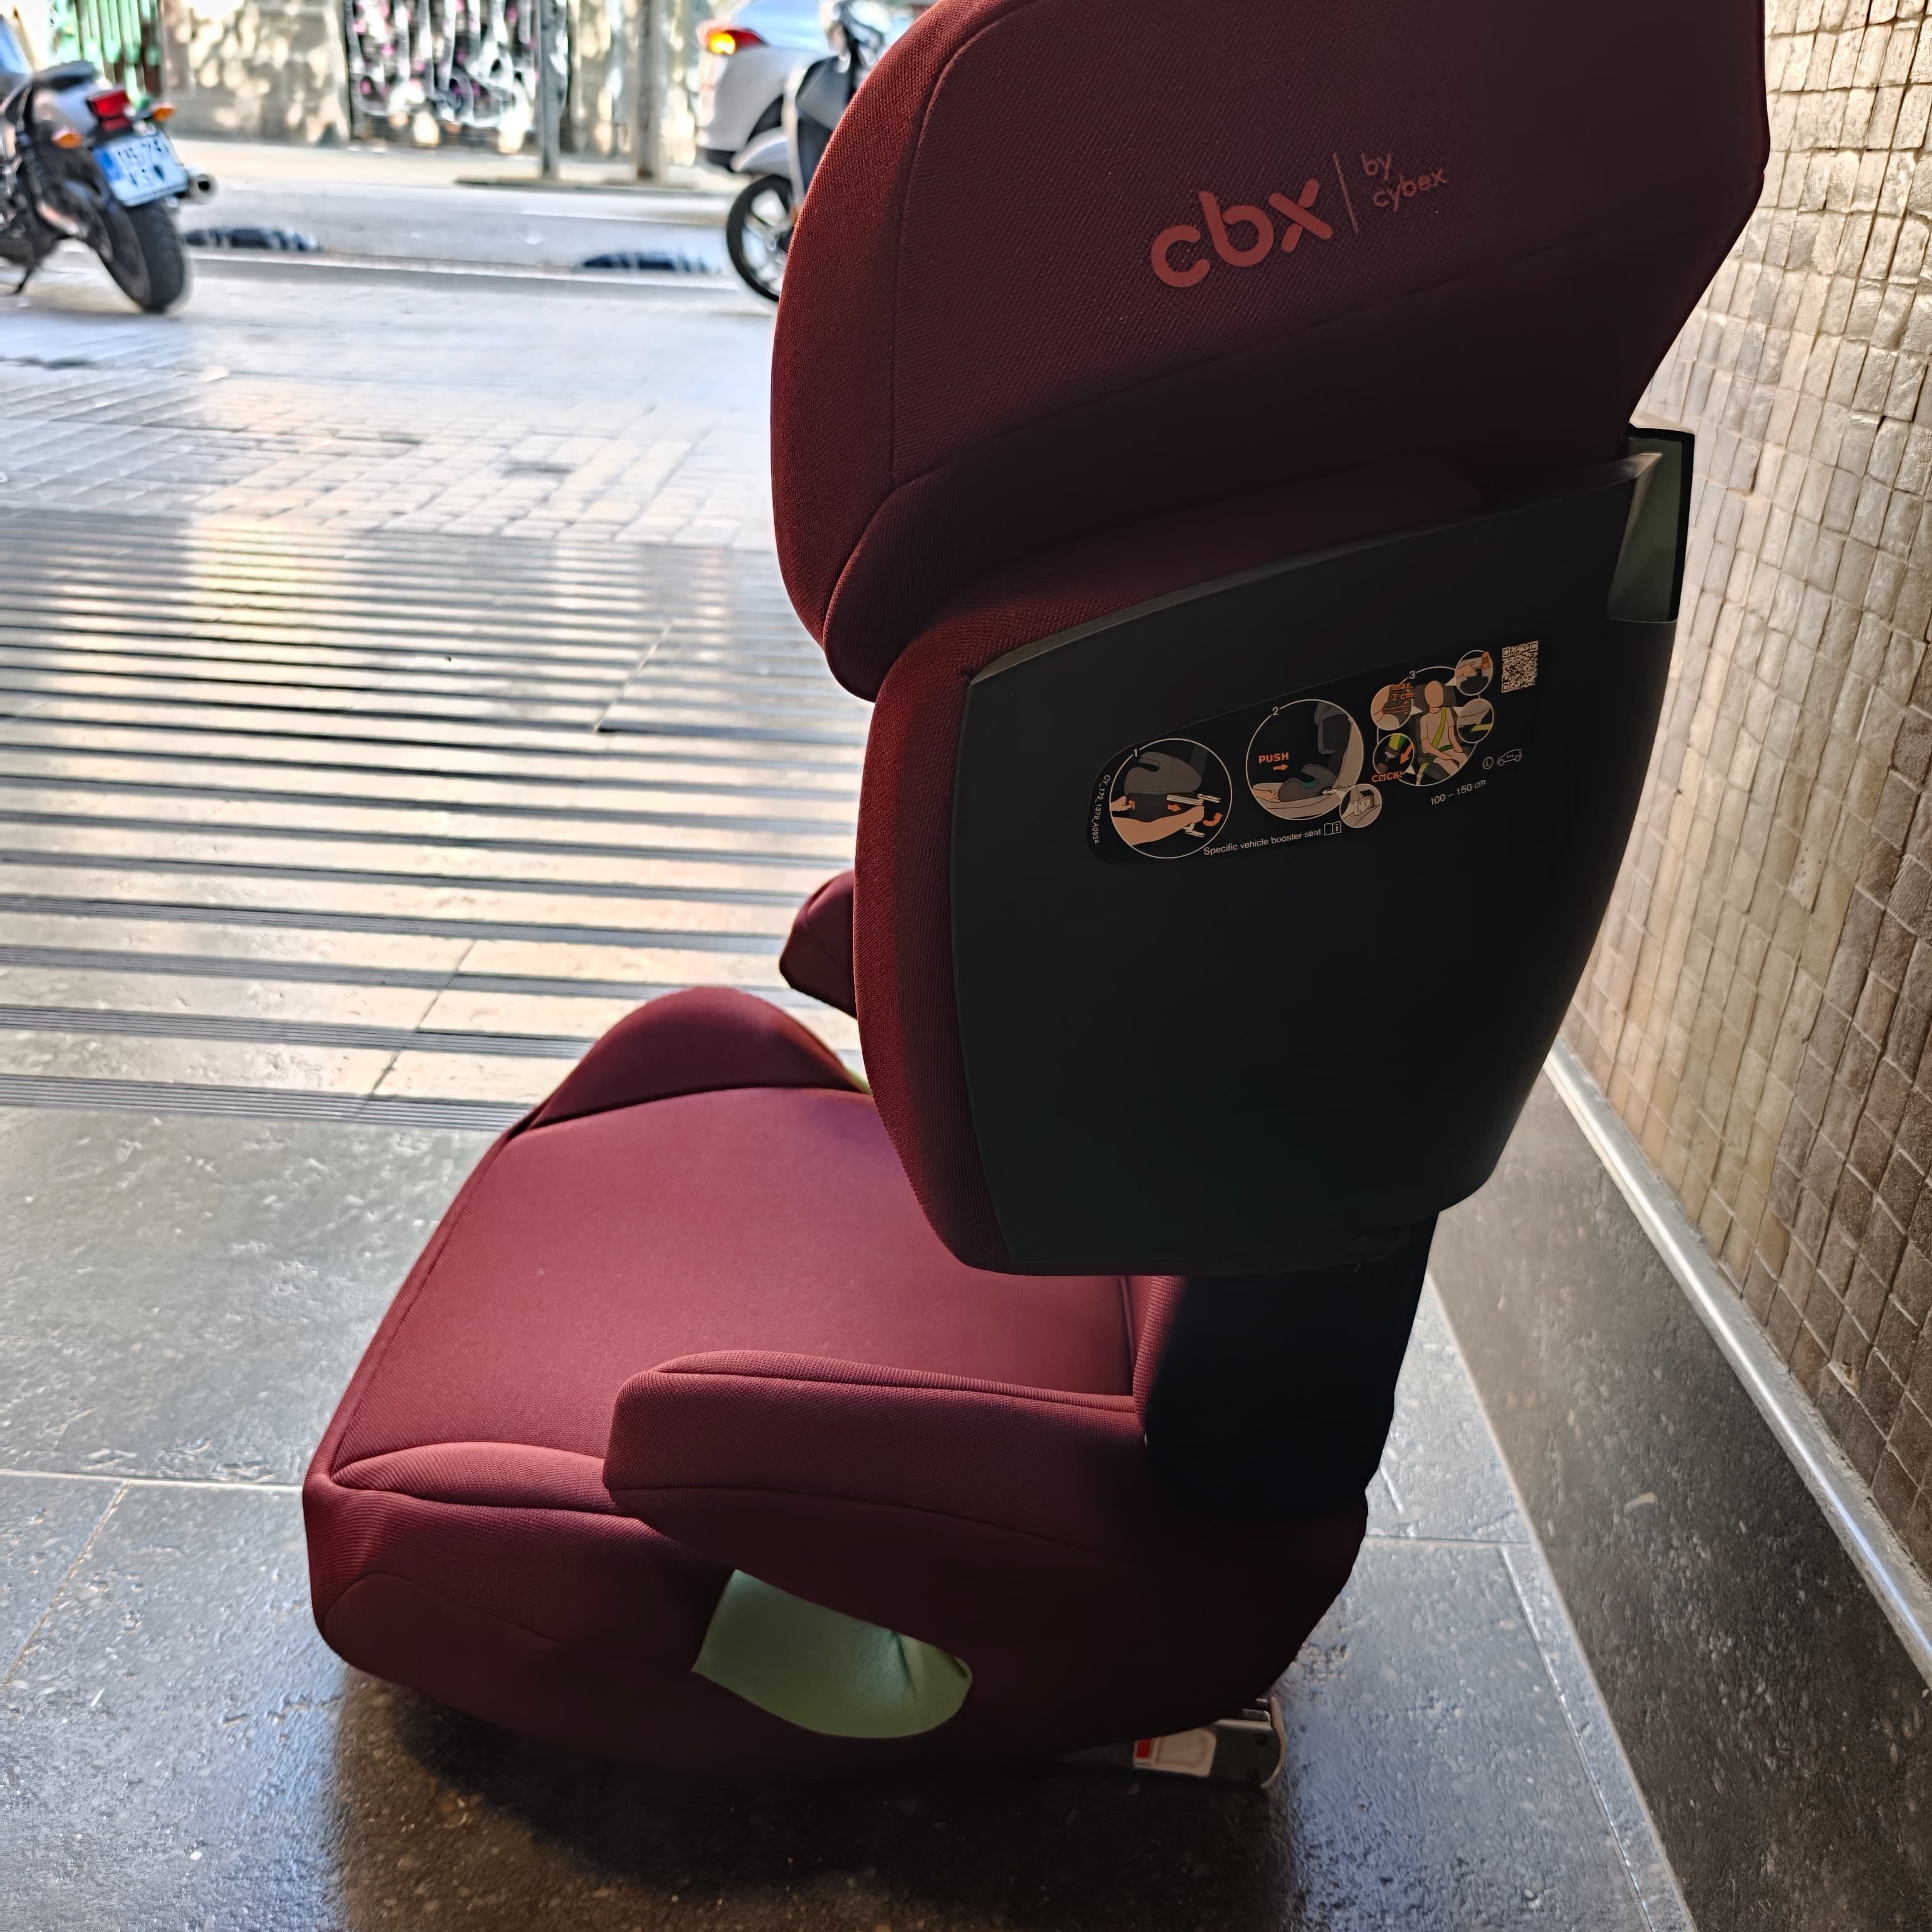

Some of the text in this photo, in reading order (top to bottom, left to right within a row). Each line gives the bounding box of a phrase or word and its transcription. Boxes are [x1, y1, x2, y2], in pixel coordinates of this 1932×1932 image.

[1360, 152, 1392, 181] by
[1373, 167, 1447, 213] cybex
[1150, 177, 1333, 288] cbx
[1409, 670, 1416, 679] 3
[1272, 706, 1279, 716] 2
[1133, 748, 1138, 757] 1
[1258, 752, 1289, 763] PUSH
[1430, 794, 1446, 805] 100
[1456, 784, 1472, 795] 150
[1474, 779, 1487, 789] cm
[1203, 828, 1321, 856] Specific vehicle booster seat
